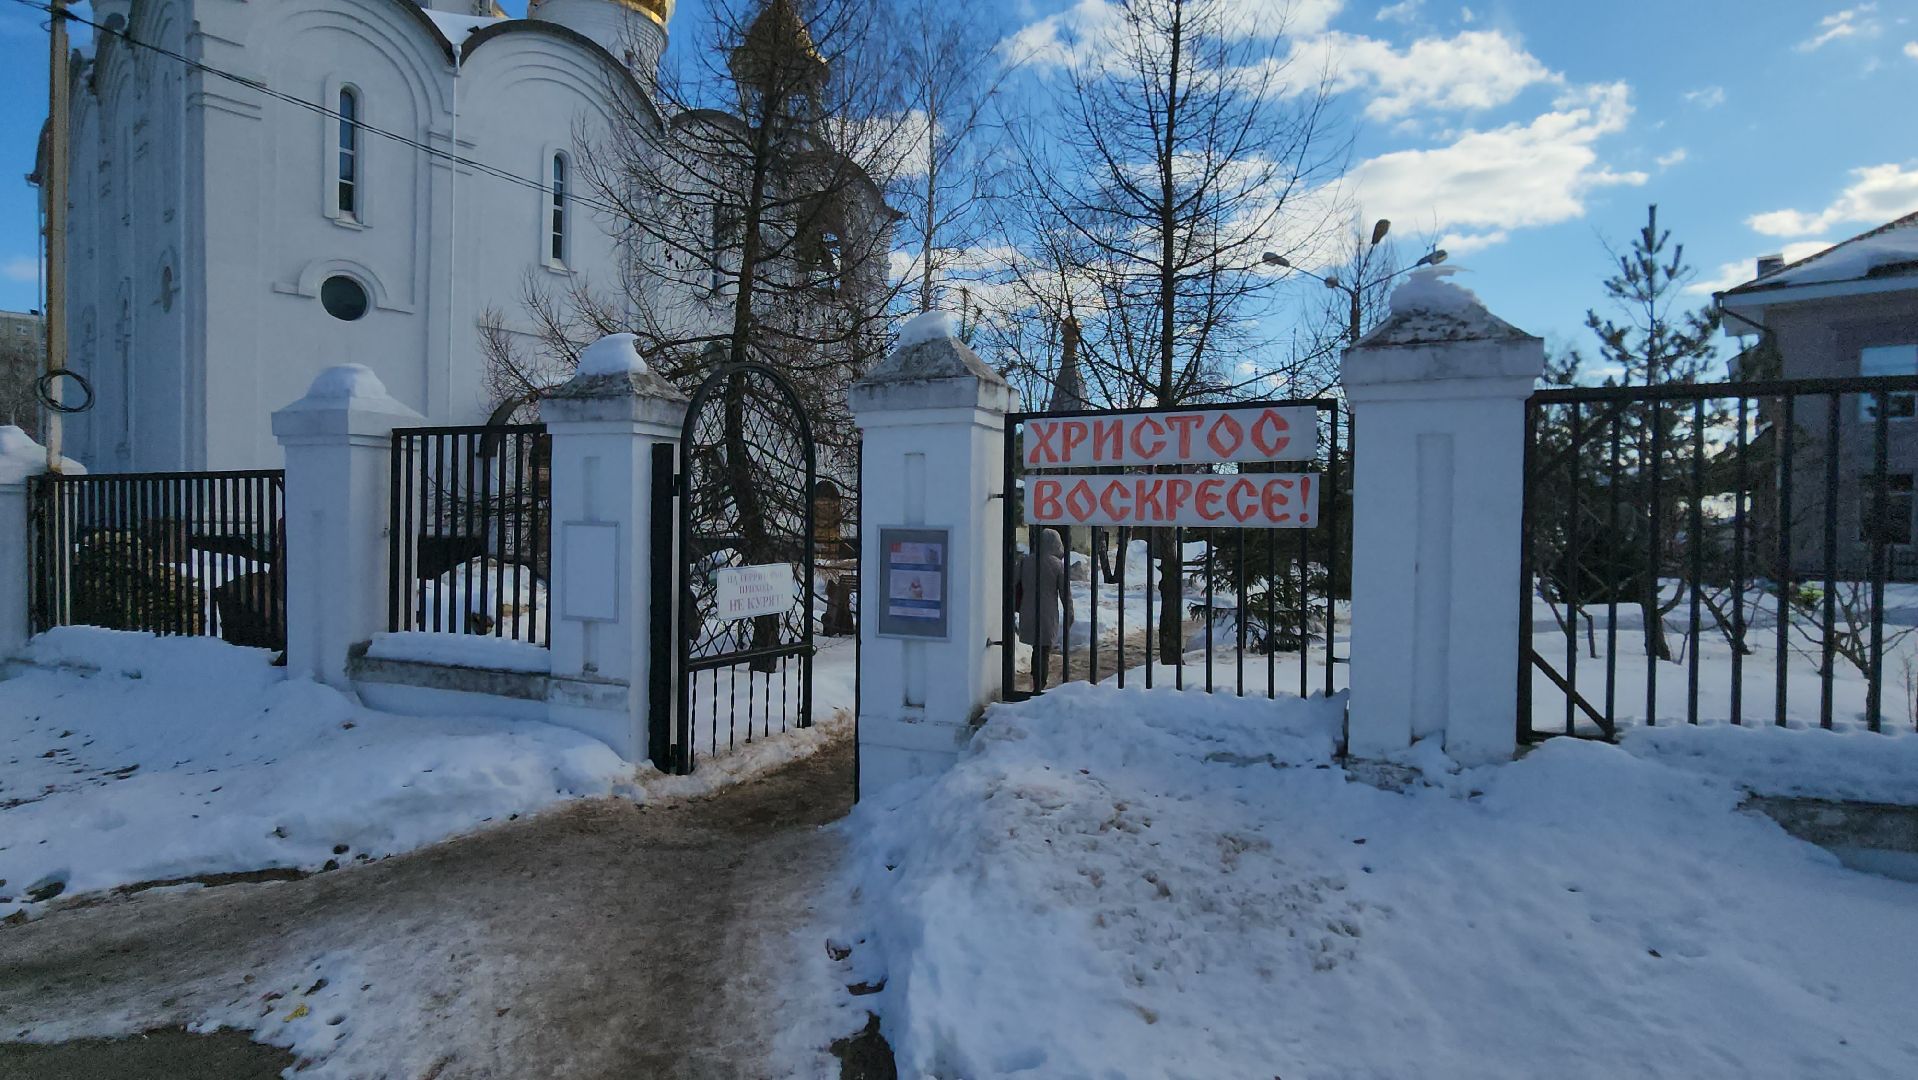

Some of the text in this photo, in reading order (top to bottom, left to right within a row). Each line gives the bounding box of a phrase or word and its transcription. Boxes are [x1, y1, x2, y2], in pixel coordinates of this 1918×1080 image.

[1029, 409, 1291, 464] ХРИСТОС
[1033, 476, 1311, 523] ВОСКРЕСЕ!
[729, 598, 744, 612] НЕ
